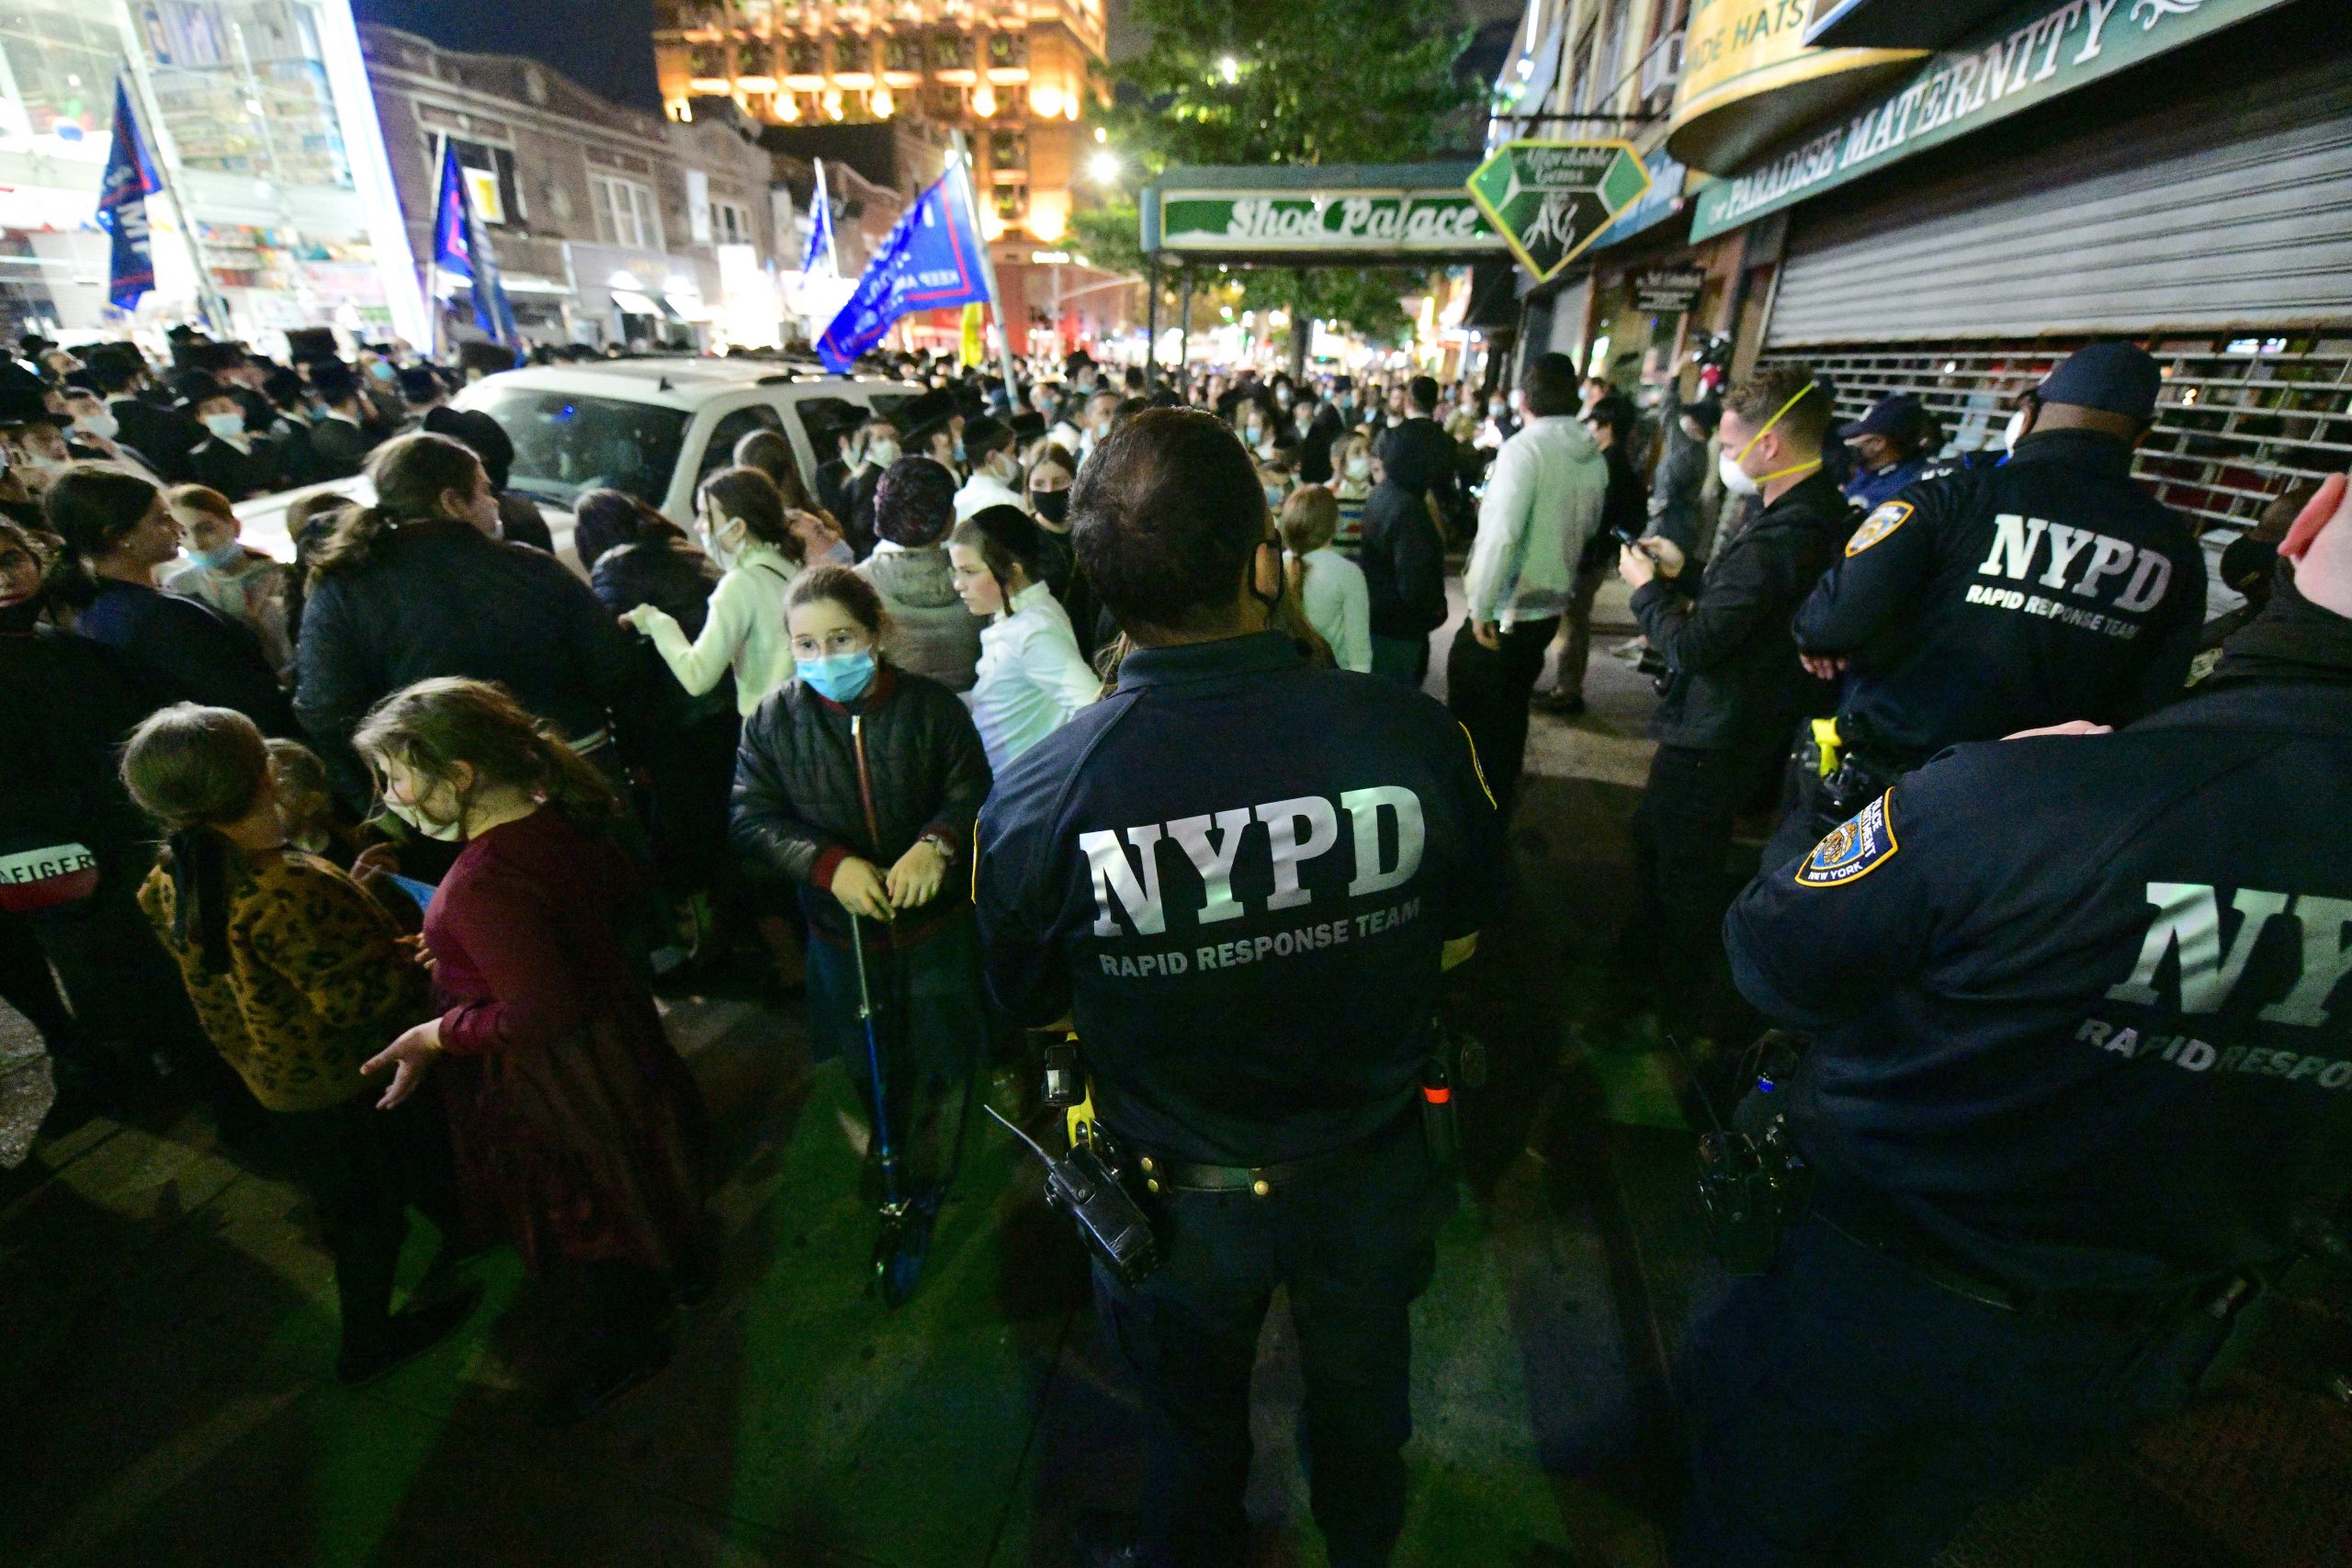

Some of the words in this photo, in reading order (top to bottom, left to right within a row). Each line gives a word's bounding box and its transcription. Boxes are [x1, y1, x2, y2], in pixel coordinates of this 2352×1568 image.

[1731, 0, 1804, 52] HATS
[1725, 127, 1842, 220] PARADISE
[1839, 0, 2114, 171] MATERNITY
[1334, 197, 1478, 241] Palace
[1978, 513, 2172, 613] NYPD
[1965, 584, 2025, 610] RAPID
[2024, 595, 2106, 631] REPONSE
[1079, 785, 1425, 937] NYPD
[1807, 871, 1828, 881] NEW
[1830, 862, 1863, 880] YORK
[1100, 952, 1188, 977] RAPID
[1197, 919, 1350, 971] RESPONSE
[1354, 897, 1422, 940] TEAM
[2074, 1018, 2217, 1073] RAPID
